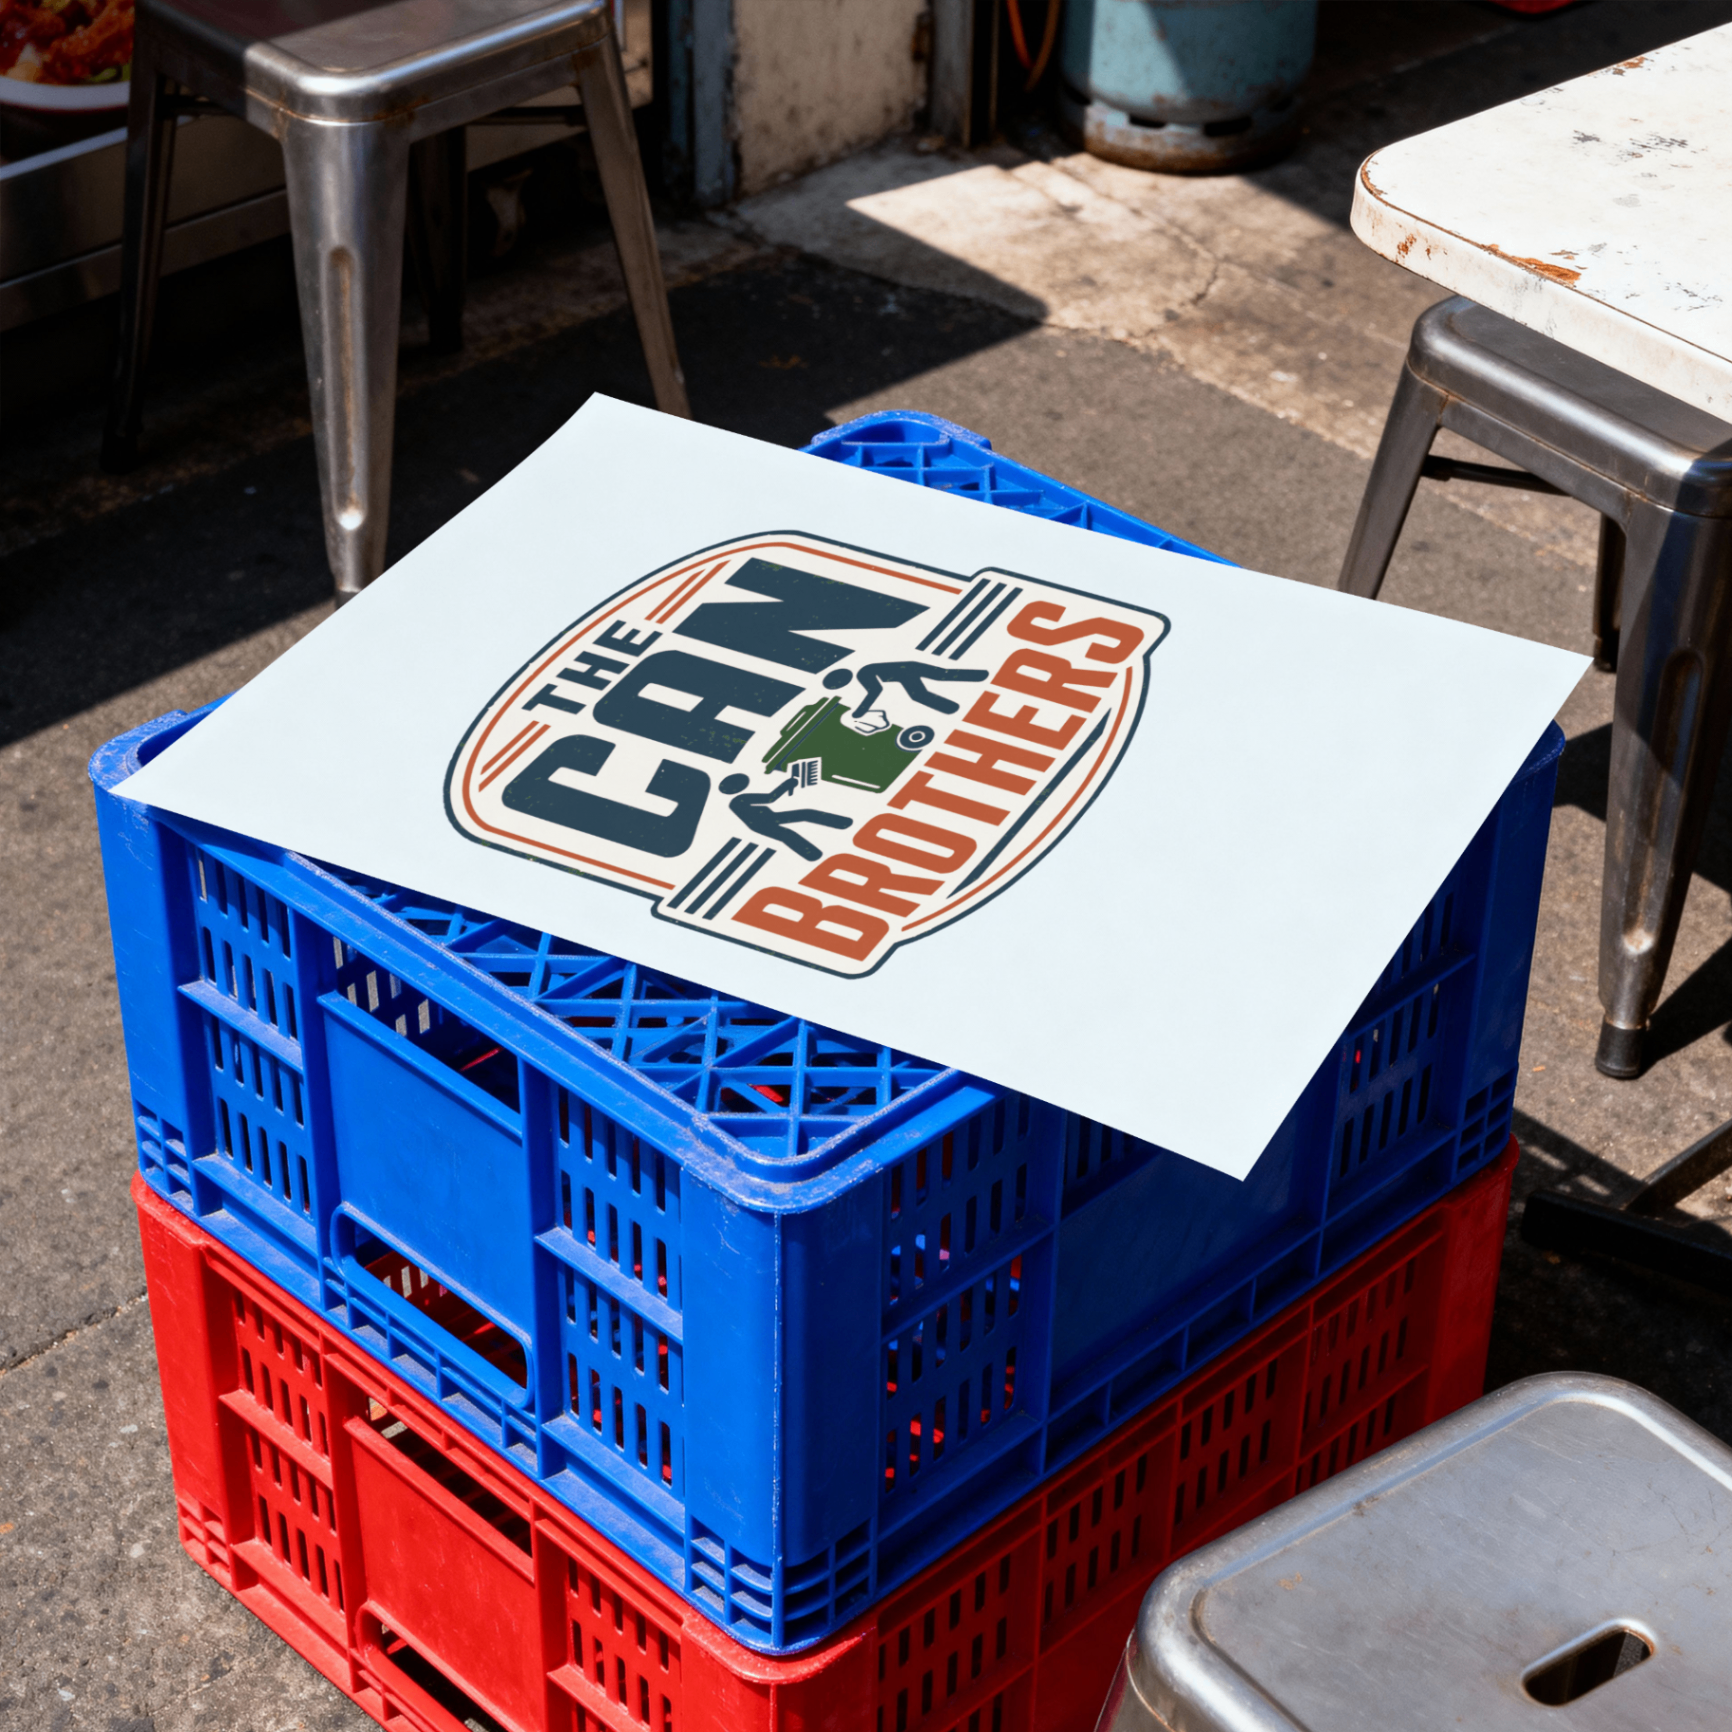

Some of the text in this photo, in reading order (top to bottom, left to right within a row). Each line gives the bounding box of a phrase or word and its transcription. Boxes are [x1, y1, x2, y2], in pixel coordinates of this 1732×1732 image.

[502, 557, 930, 858] CAN
[522, 619, 663, 715] THE
[732, 600, 1145, 962] BROTHERS
